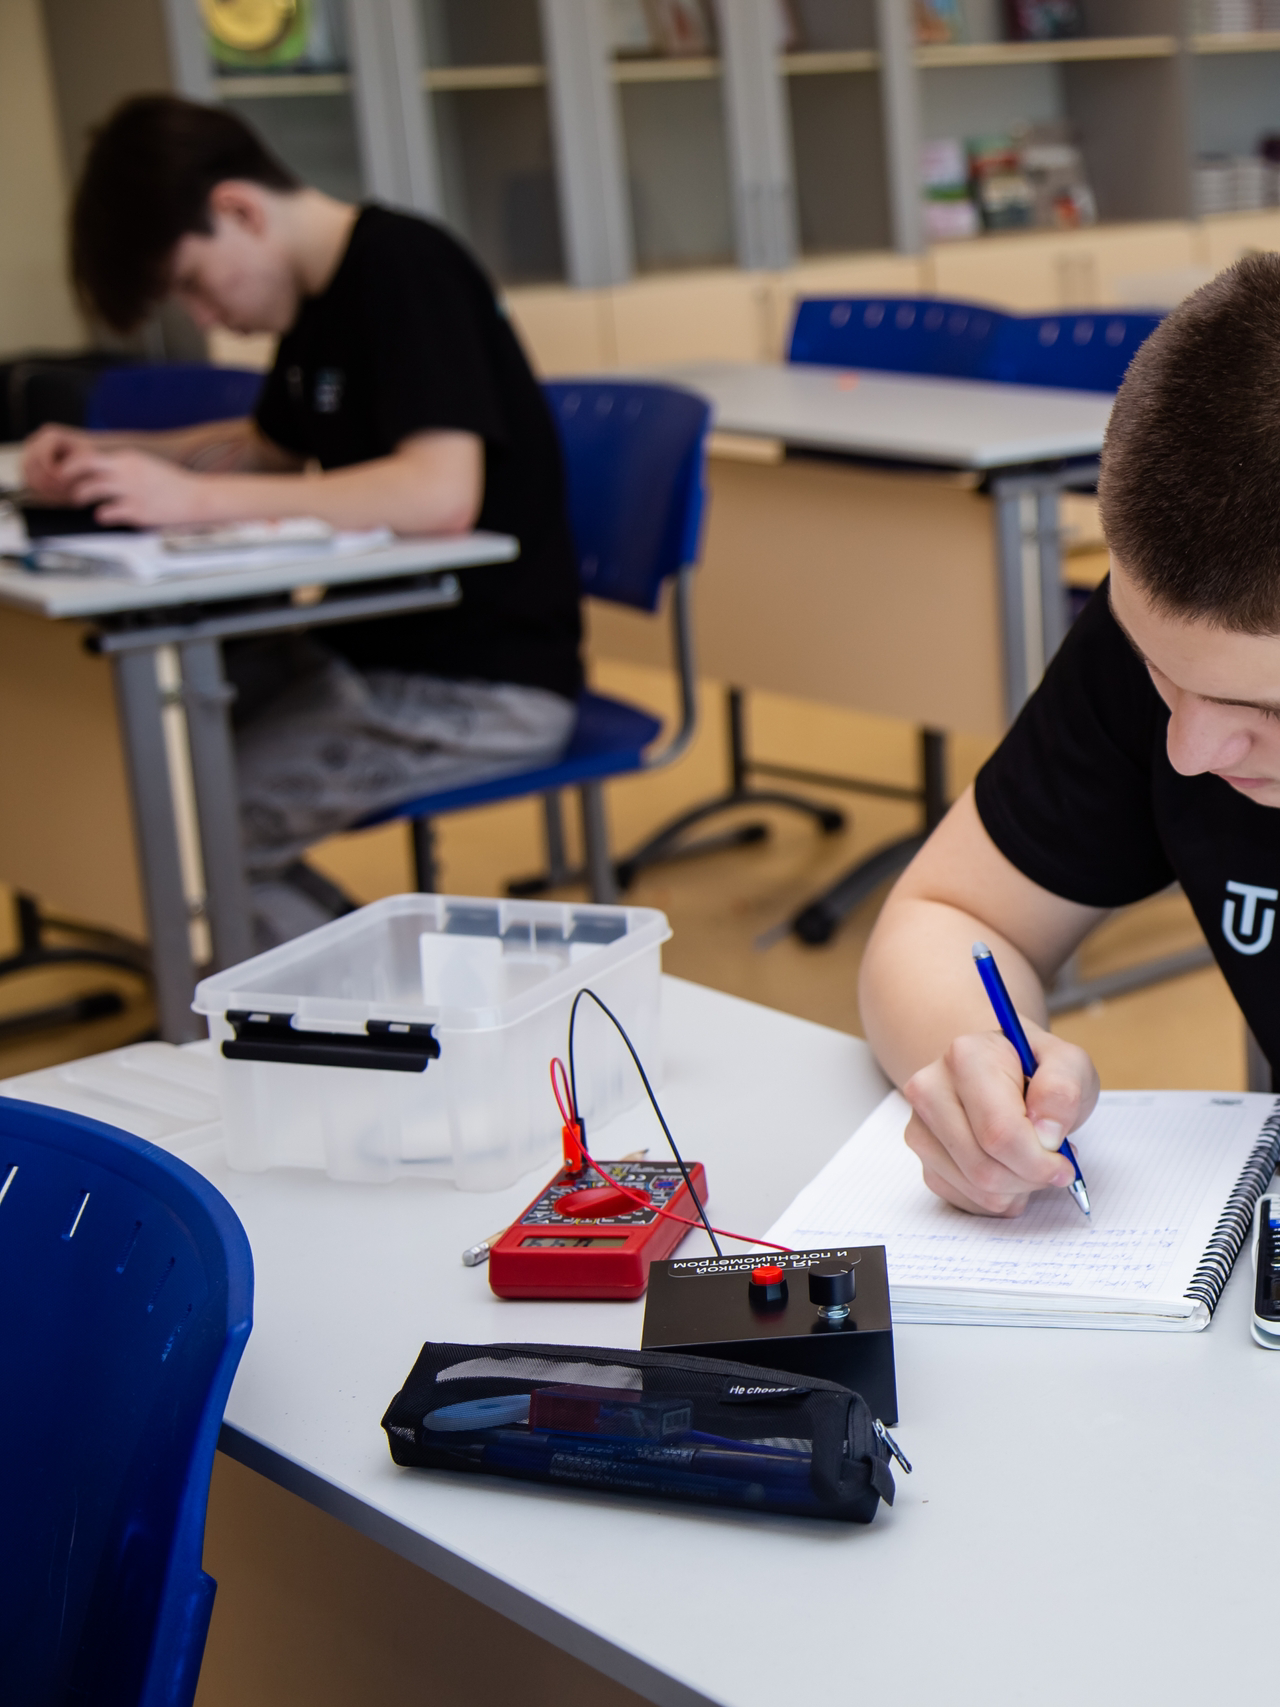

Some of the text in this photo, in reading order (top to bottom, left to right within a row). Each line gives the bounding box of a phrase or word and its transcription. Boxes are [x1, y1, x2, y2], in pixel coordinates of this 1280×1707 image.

[673, 1253, 831, 1269] потенциометром
[696, 1263, 771, 1275] кнопкой
[729, 1385, 746, 1395] He
